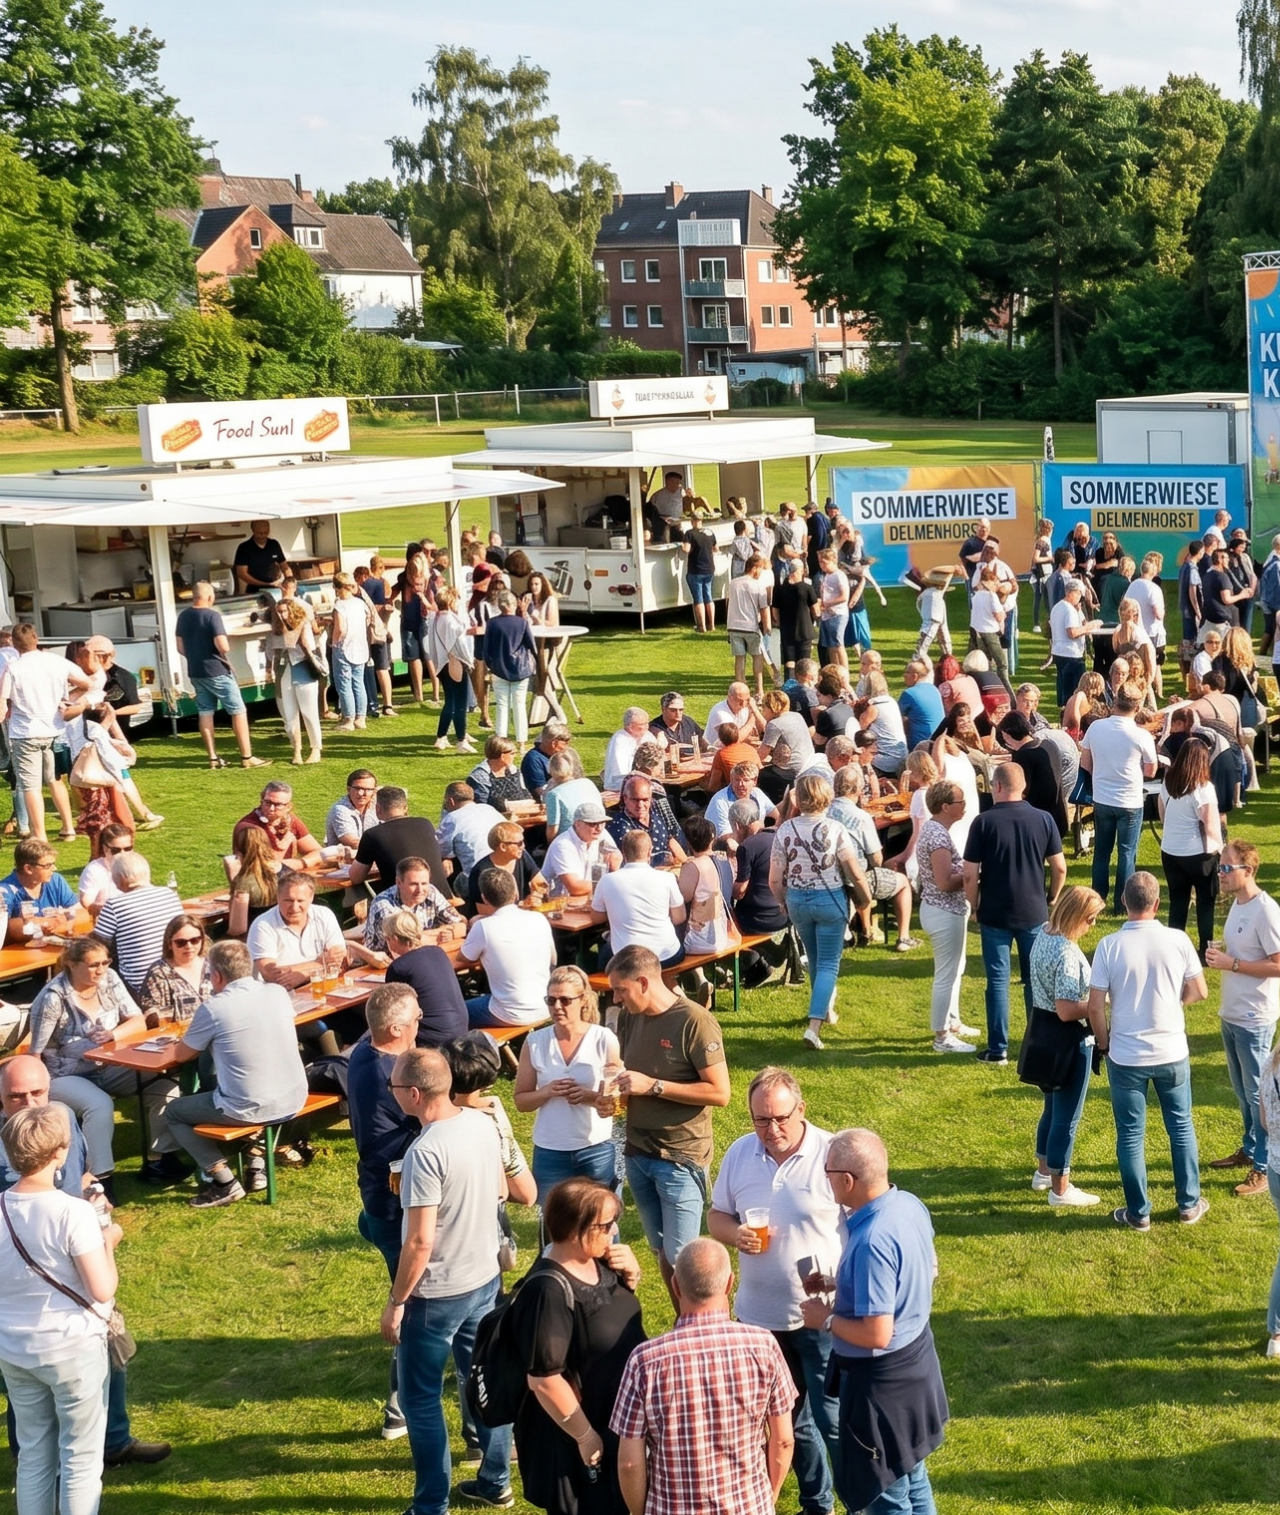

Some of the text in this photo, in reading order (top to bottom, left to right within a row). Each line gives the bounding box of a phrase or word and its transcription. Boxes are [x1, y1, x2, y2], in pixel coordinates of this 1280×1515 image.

[212, 418, 254, 442] Food
[1069, 480, 1220, 506] SOMMERWIESE
[860, 492, 1010, 520] SOMMERWIESE
[889, 523, 978, 541] DELMENHORS
[1096, 511, 1194, 529] DELMENHORST
